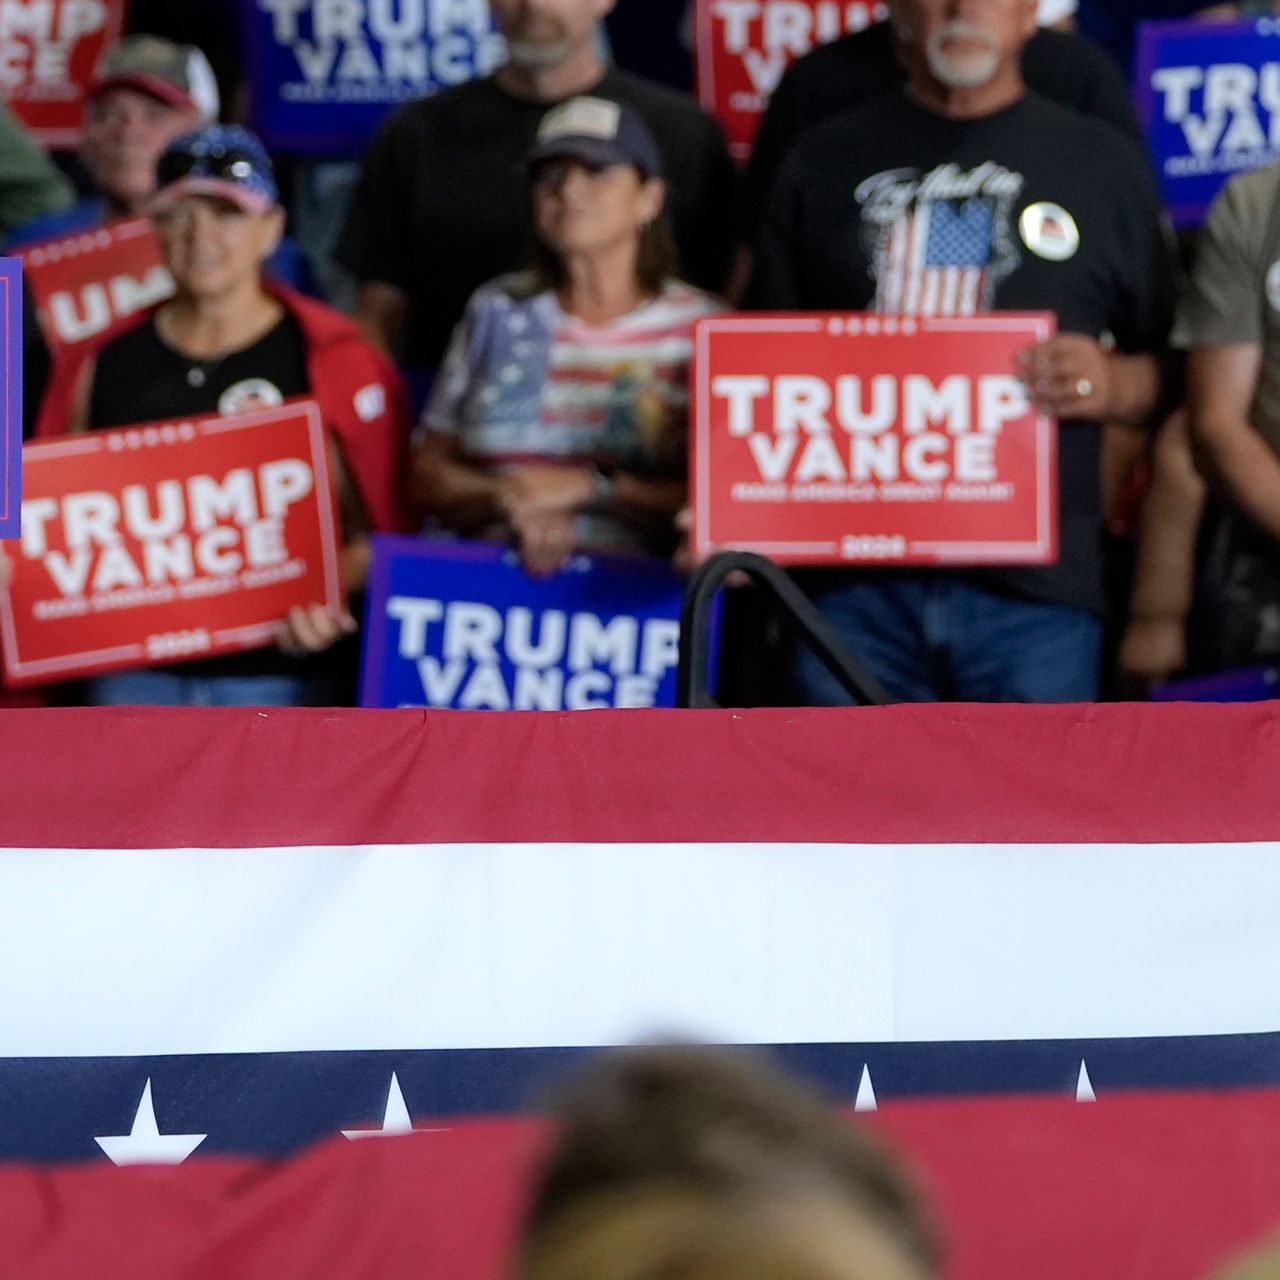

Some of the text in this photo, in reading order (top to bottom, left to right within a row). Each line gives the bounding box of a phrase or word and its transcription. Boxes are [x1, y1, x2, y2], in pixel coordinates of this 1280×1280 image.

[712, 374, 1034, 438] TRUMP
[747, 432, 1000, 482] VANCE
[20, 458, 316, 558] TRUMP
[44, 519, 289, 597] VANCE
[387, 595, 681, 680] TRUMP
[416, 654, 658, 710] VANCE
